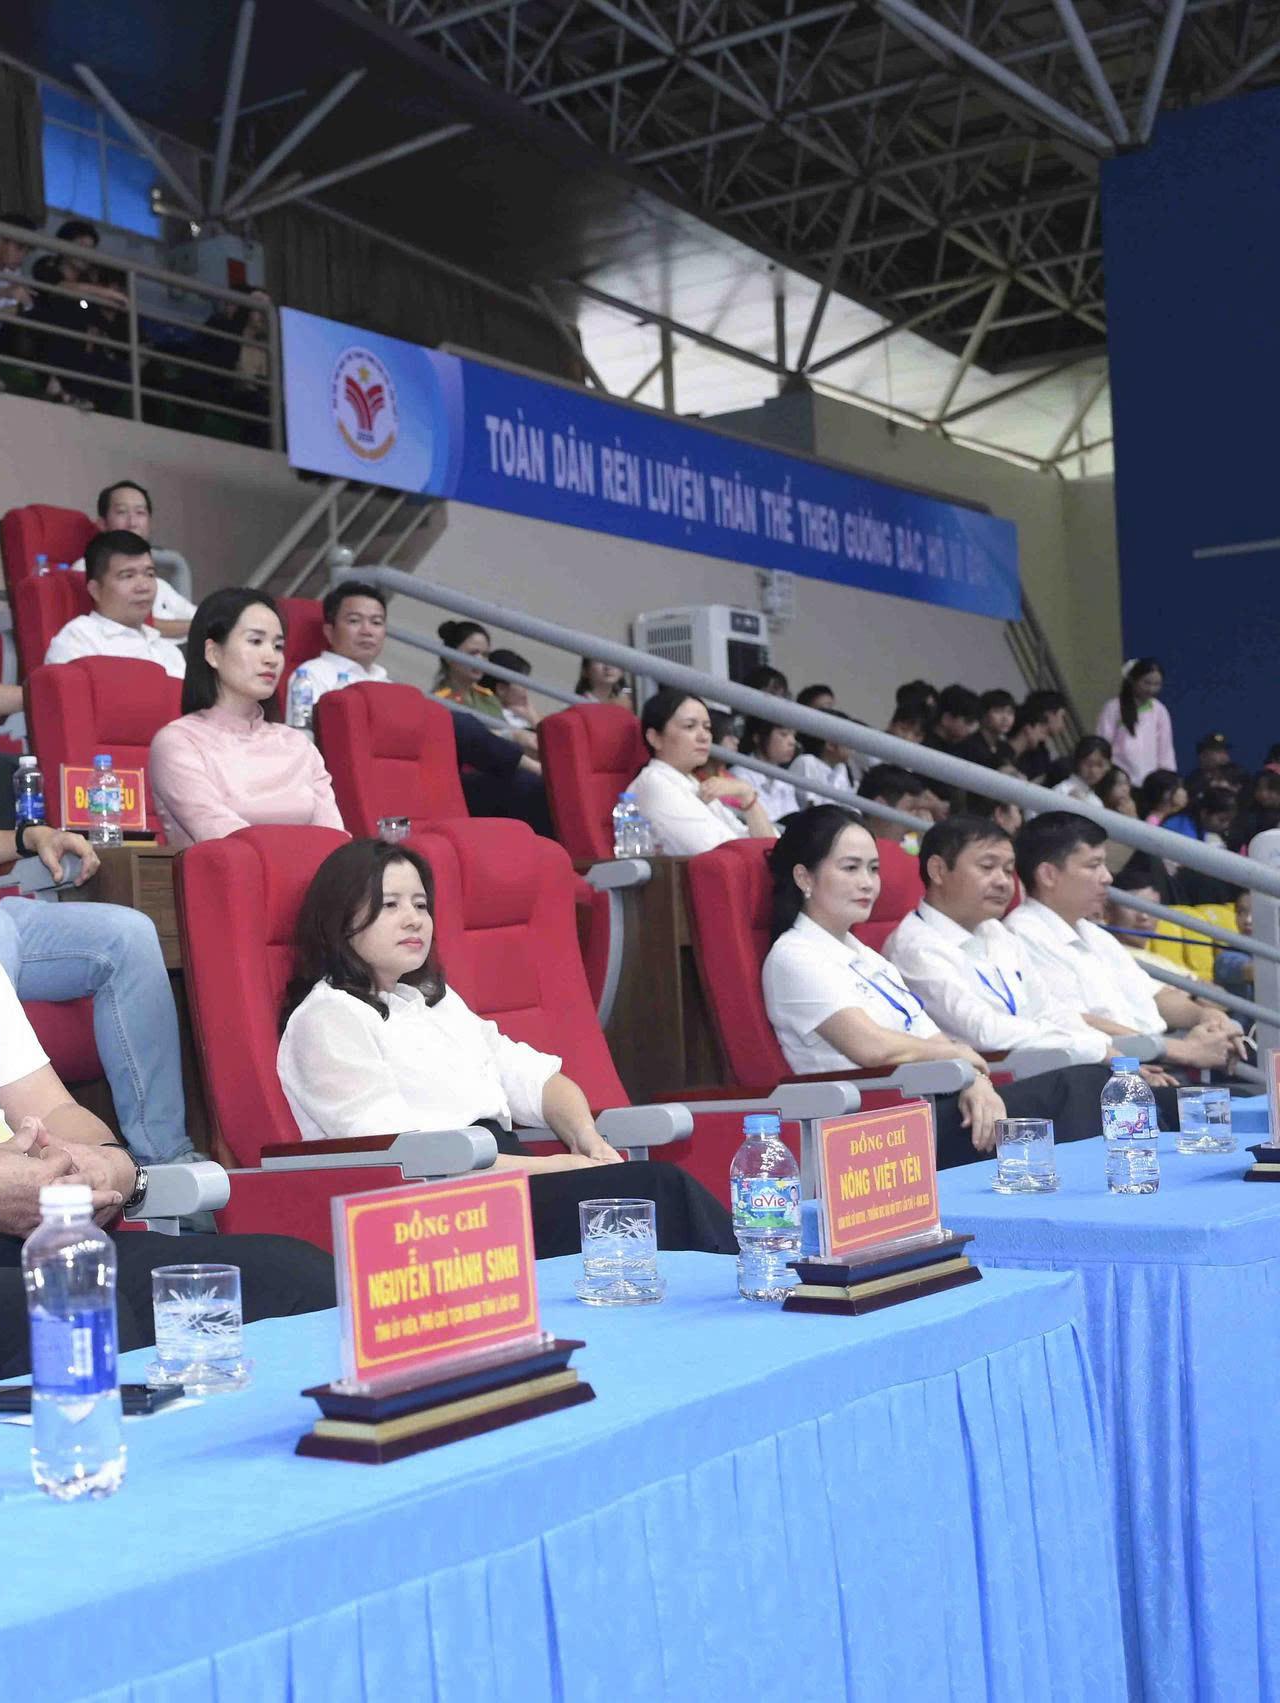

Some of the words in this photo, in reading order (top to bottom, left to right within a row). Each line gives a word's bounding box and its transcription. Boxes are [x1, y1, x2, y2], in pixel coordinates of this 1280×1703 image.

[485, 408, 546, 484] TOÀN
[552, 424, 595, 496] DÂN
[601, 435, 641, 507] RÈN
[646, 456, 705, 535] LUYỆN
[710, 470, 757, 535] THÂN
[761, 475, 794, 544] THỂ
[797, 500, 839, 554] THEO
[850, 1130, 883, 1156] ĐỒNG
[887, 1125, 906, 1147] CHÍ
[840, 1165, 870, 1200] NÔNG
[874, 1155, 897, 1197] VIỆT
[901, 1152, 922, 1185] YÊN
[394, 1210, 450, 1244] ĐỒNG
[455, 1201, 488, 1231] CHÍ
[368, 1247, 431, 1309] NGUYỄN
[432, 1247, 484, 1294] THÀNH
[486, 1244, 520, 1282] SINH
